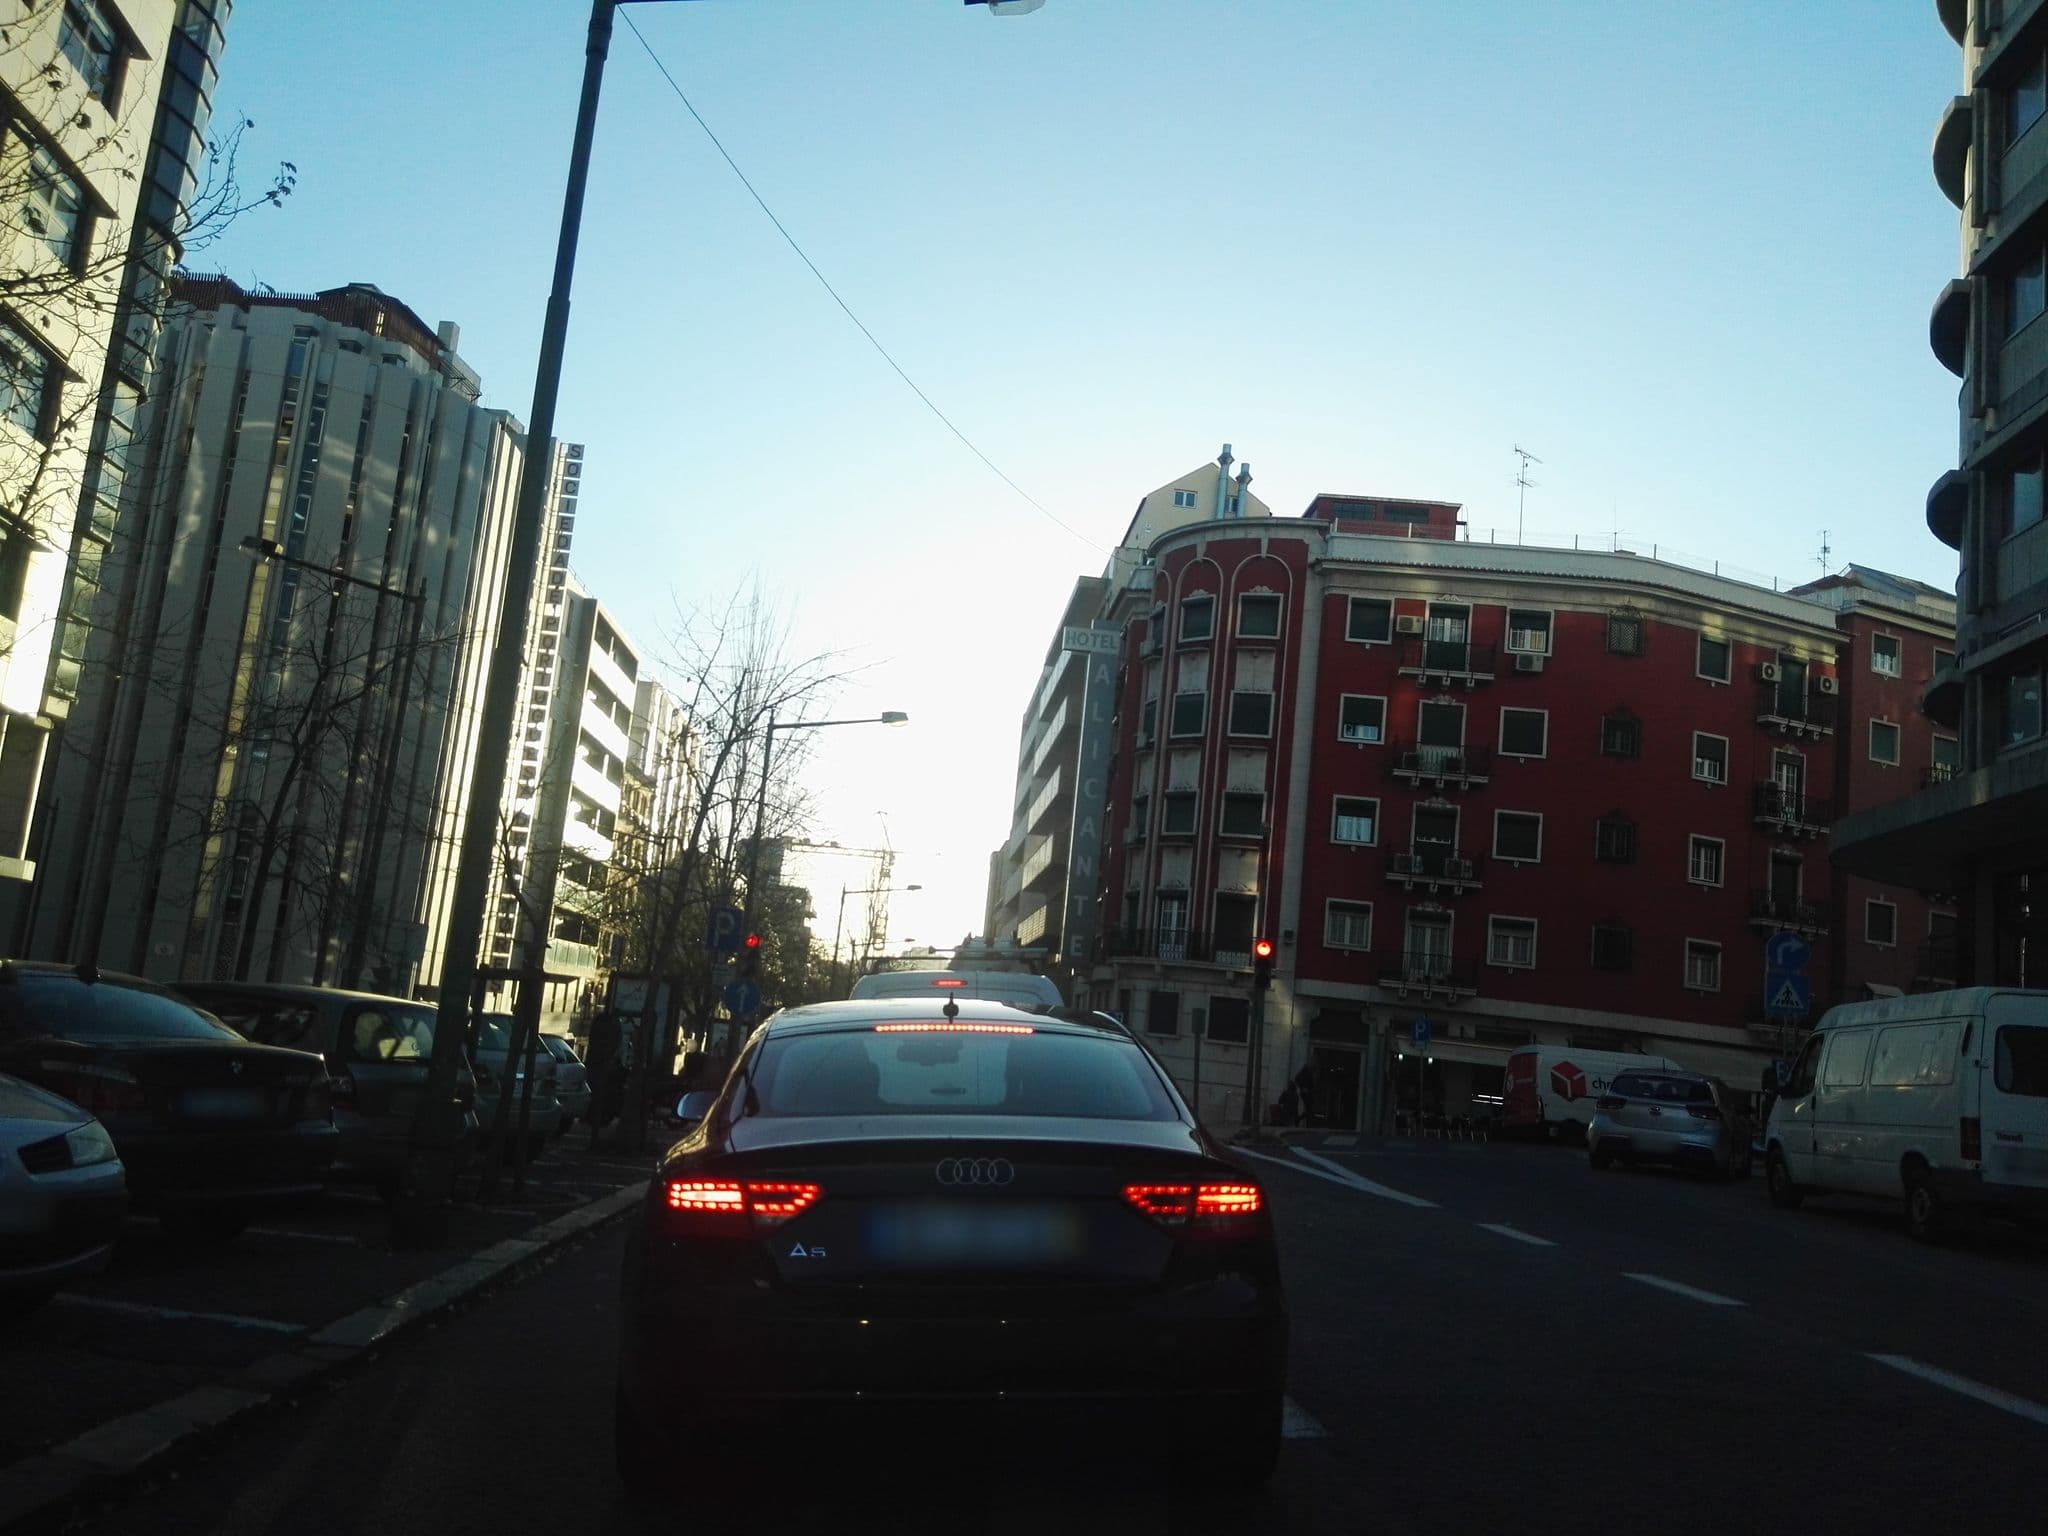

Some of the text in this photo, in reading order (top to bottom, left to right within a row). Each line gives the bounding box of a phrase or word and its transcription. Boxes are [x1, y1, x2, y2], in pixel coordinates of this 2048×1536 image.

[1066, 631, 1117, 649] HOTEL
[1070, 663, 1110, 956] ALICANTE
[713, 911, 736, 947] P
[1415, 1020, 1427, 1039] P
[790, 1242, 826, 1257] A5
